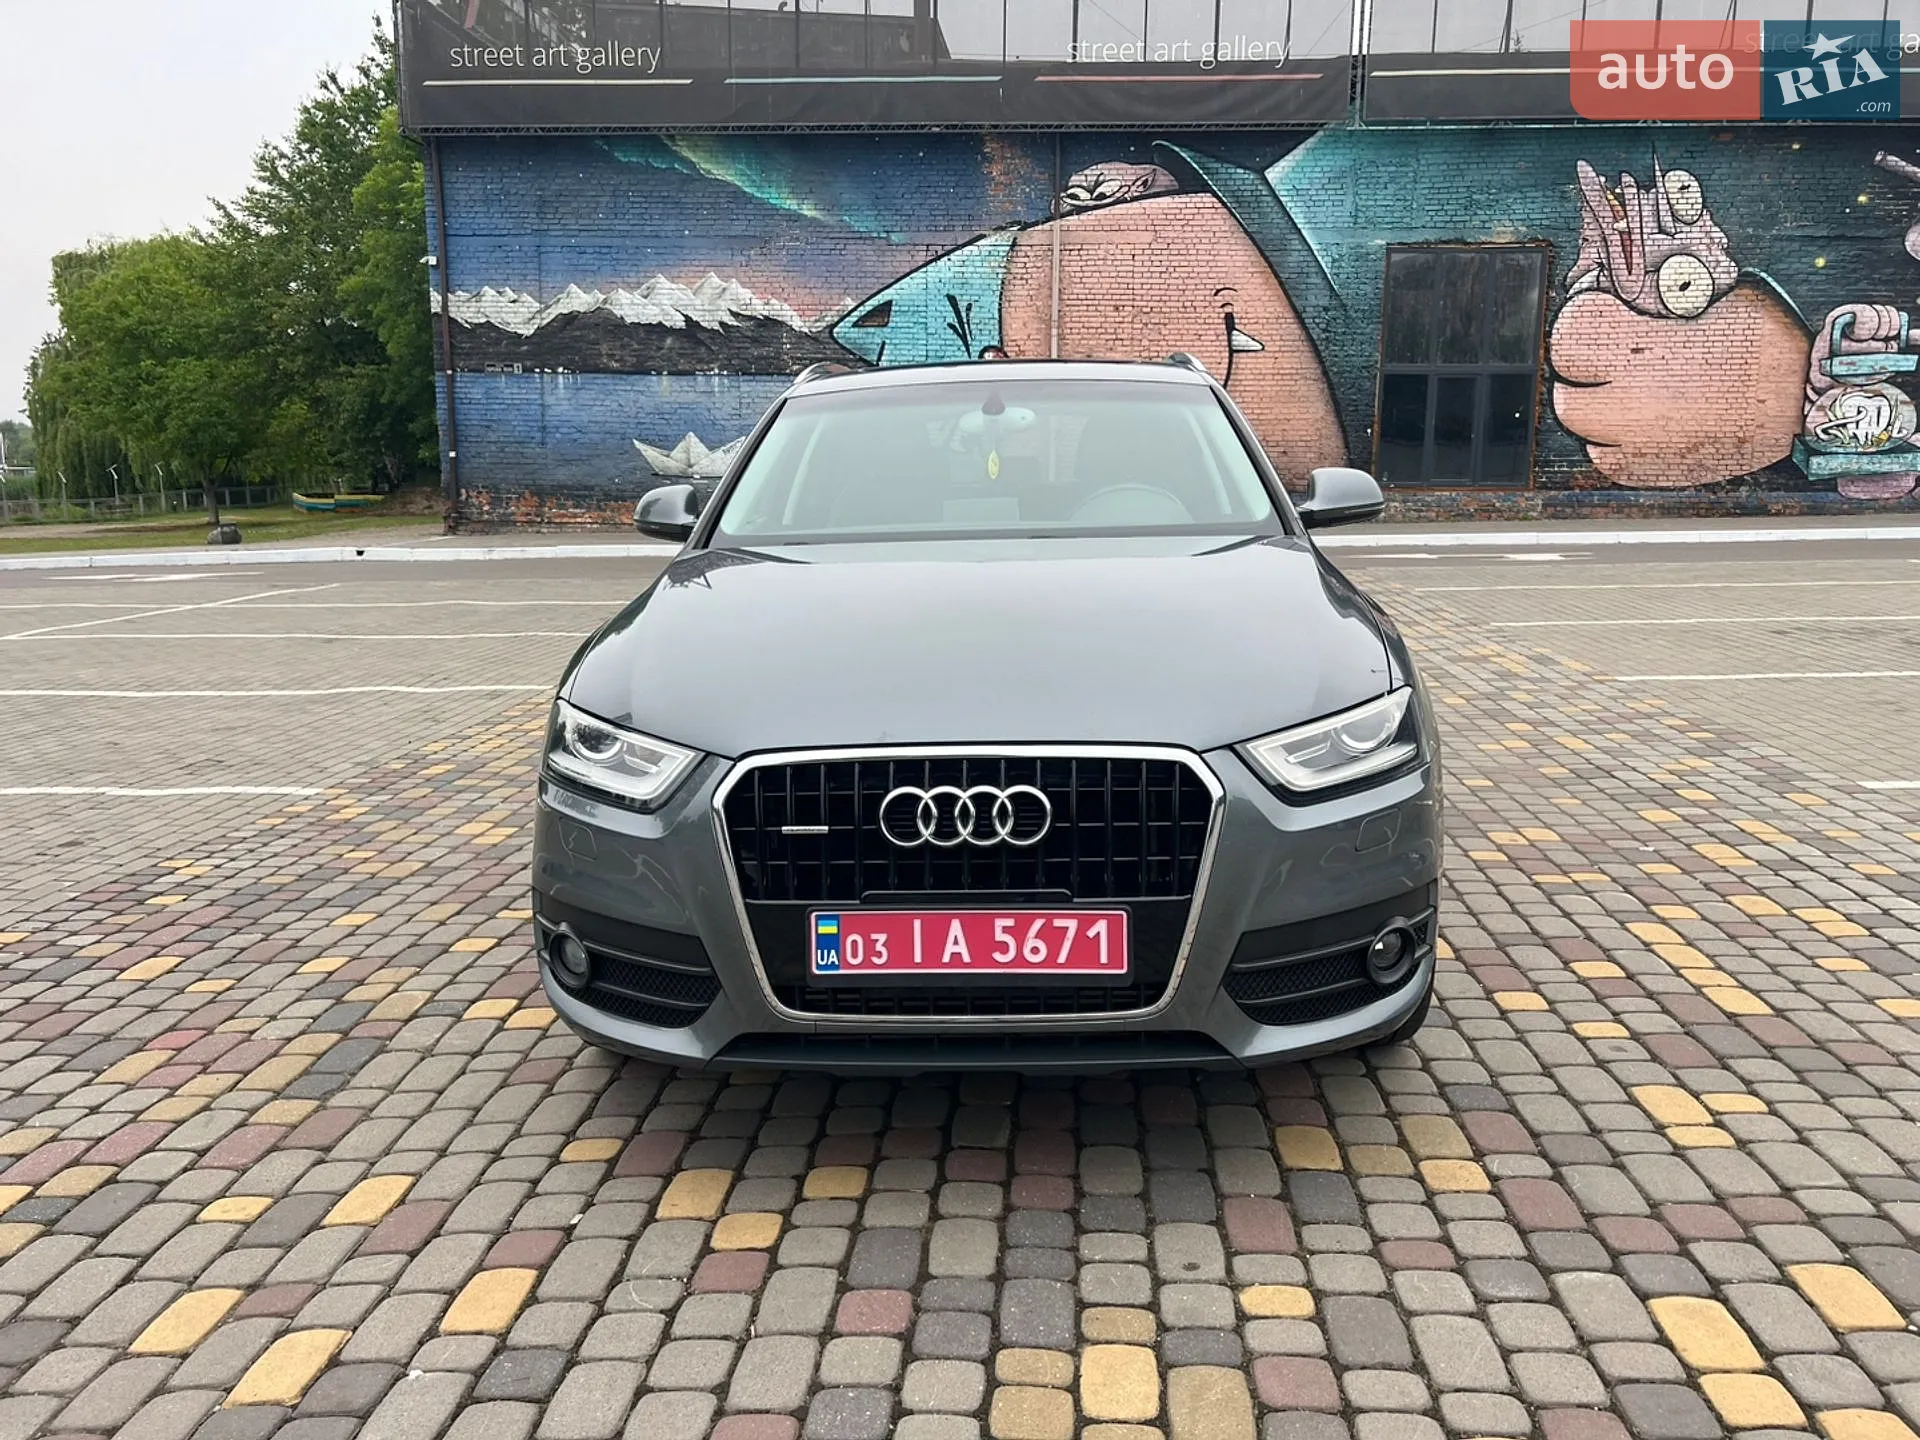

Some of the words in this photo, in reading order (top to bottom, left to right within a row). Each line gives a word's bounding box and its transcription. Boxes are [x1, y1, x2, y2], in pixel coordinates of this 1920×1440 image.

[450, 43, 524, 67] street
[532, 43, 569, 67] art
[575, 40, 661, 74] gallery
[1066, 39, 1146, 63] street
[1154, 39, 1192, 62] art
[1199, 36, 1291, 70] gallery
[817, 949, 839, 965] UA
[845, 933, 888, 965] 03
[991, 918, 1109, 964] 5671
